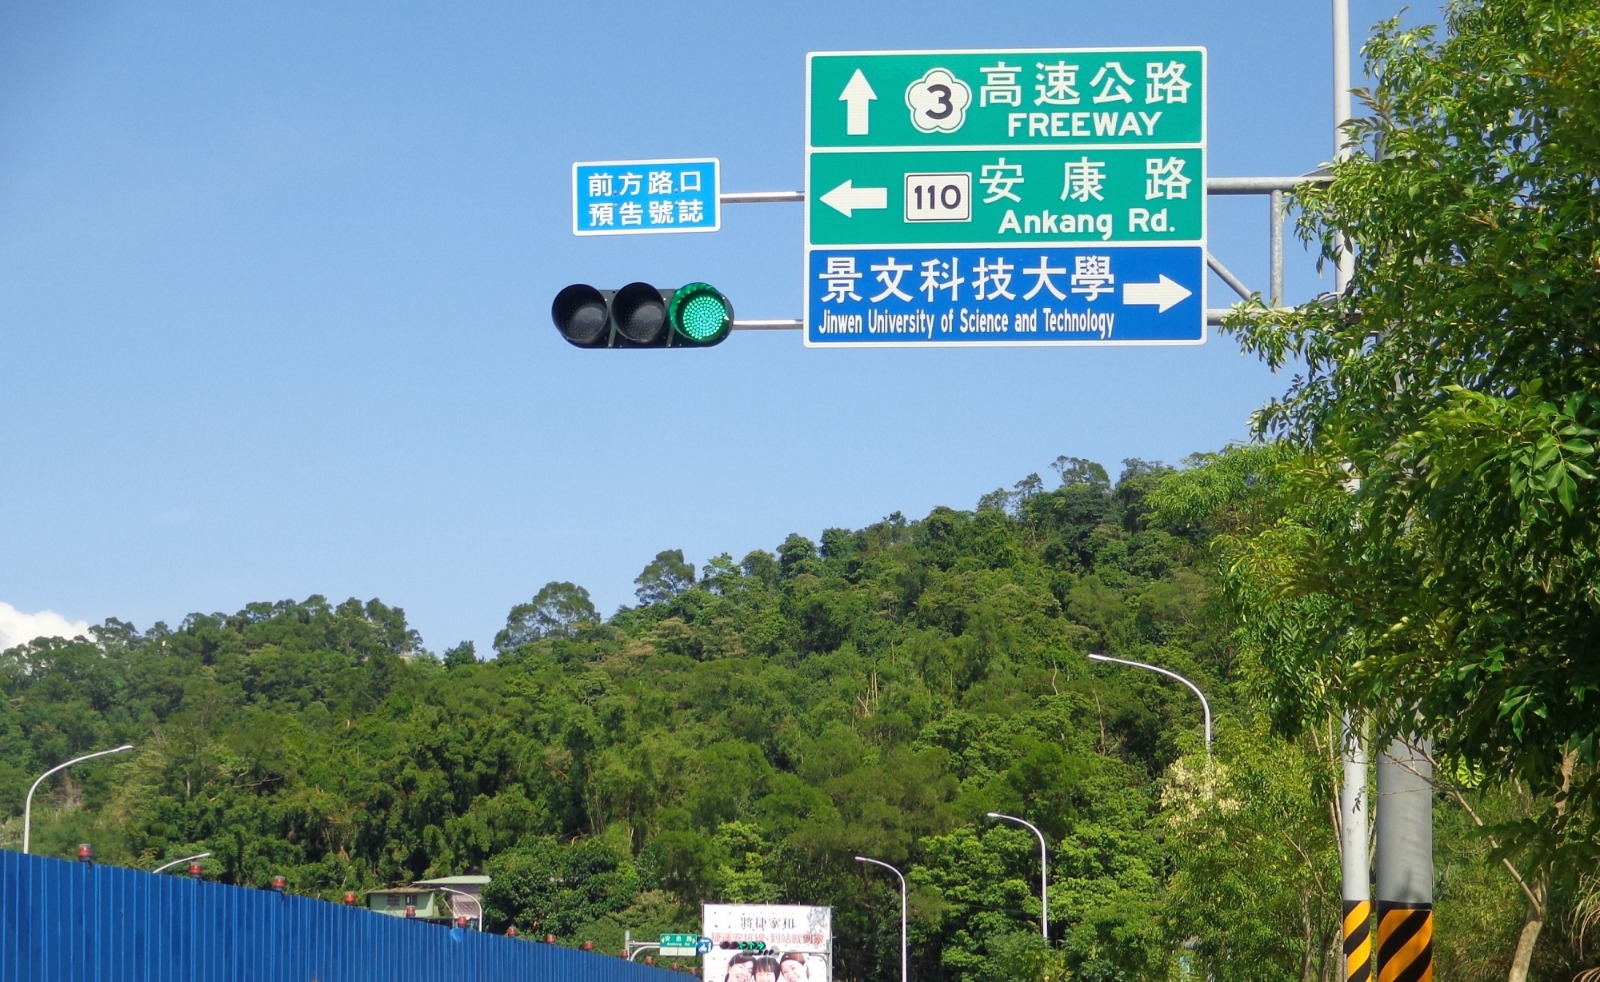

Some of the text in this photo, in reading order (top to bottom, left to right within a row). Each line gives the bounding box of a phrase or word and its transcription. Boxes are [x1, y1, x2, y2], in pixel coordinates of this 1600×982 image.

[979, 60, 1193, 108] 高速公路
[925, 84, 953, 120] 3
[1007, 111, 1163, 138] FREEWAY
[588, 170, 702, 198] 前方路口
[979, 156, 1192, 204] 安康路
[588, 199, 704, 227] 預告號誌
[913, 184, 962, 210] 110
[997, 208, 1176, 240] Ankang Rd.
[818, 254, 1115, 304] 景文科技大學
[818, 306, 1115, 339] Jinwen University of Science and Technology
